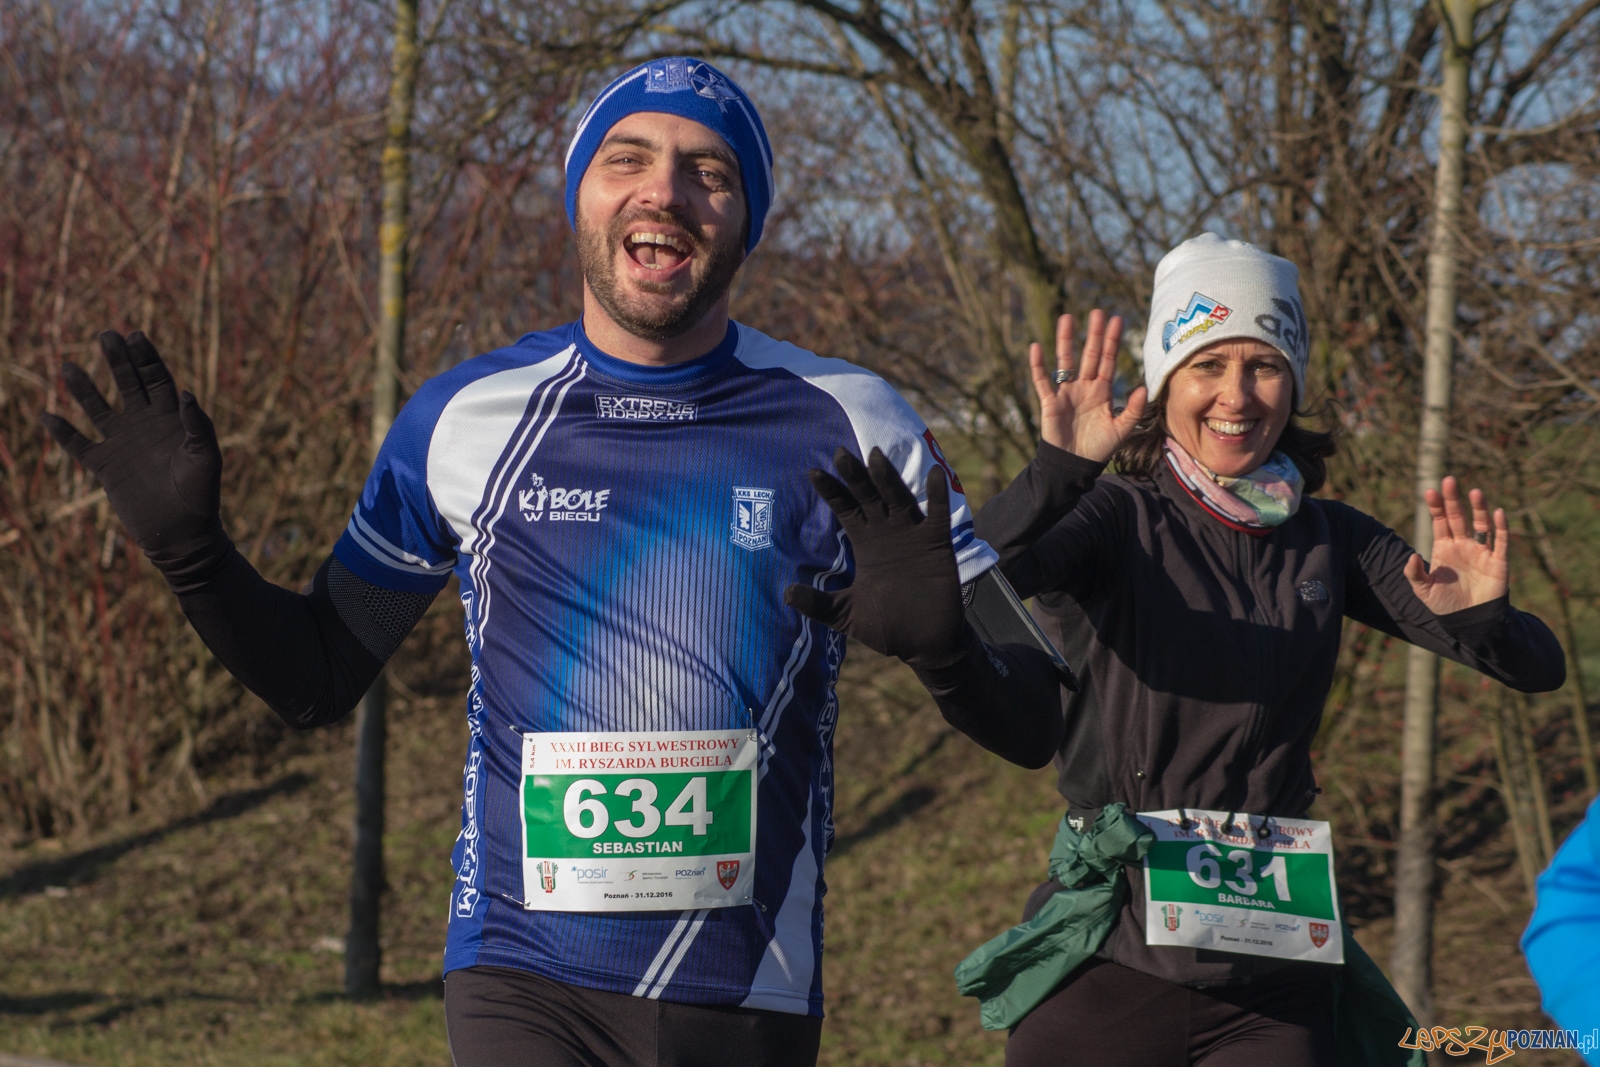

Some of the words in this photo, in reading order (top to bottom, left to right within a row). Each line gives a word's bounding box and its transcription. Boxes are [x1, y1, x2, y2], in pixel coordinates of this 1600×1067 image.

[598, 396, 695, 414] EXTREME
[524, 512, 543, 522] W
[549, 511, 600, 522] BIEGU
[551, 742, 587, 753] XXXII
[590, 741, 624, 753] BIEG
[628, 738, 739, 752] SYLWESTROWY
[555, 758, 576, 769] IM.
[579, 757, 656, 769] RYSZARDA
[660, 755, 733, 768] BURGIELA
[563, 776, 714, 839] 634
[1174, 830, 1193, 838] IM.
[593, 841, 683, 854] SEBASTIAN
[577, 866, 608, 880] posir
[1186, 843, 1292, 902] 631
[1218, 893, 1275, 909] BARBARA
